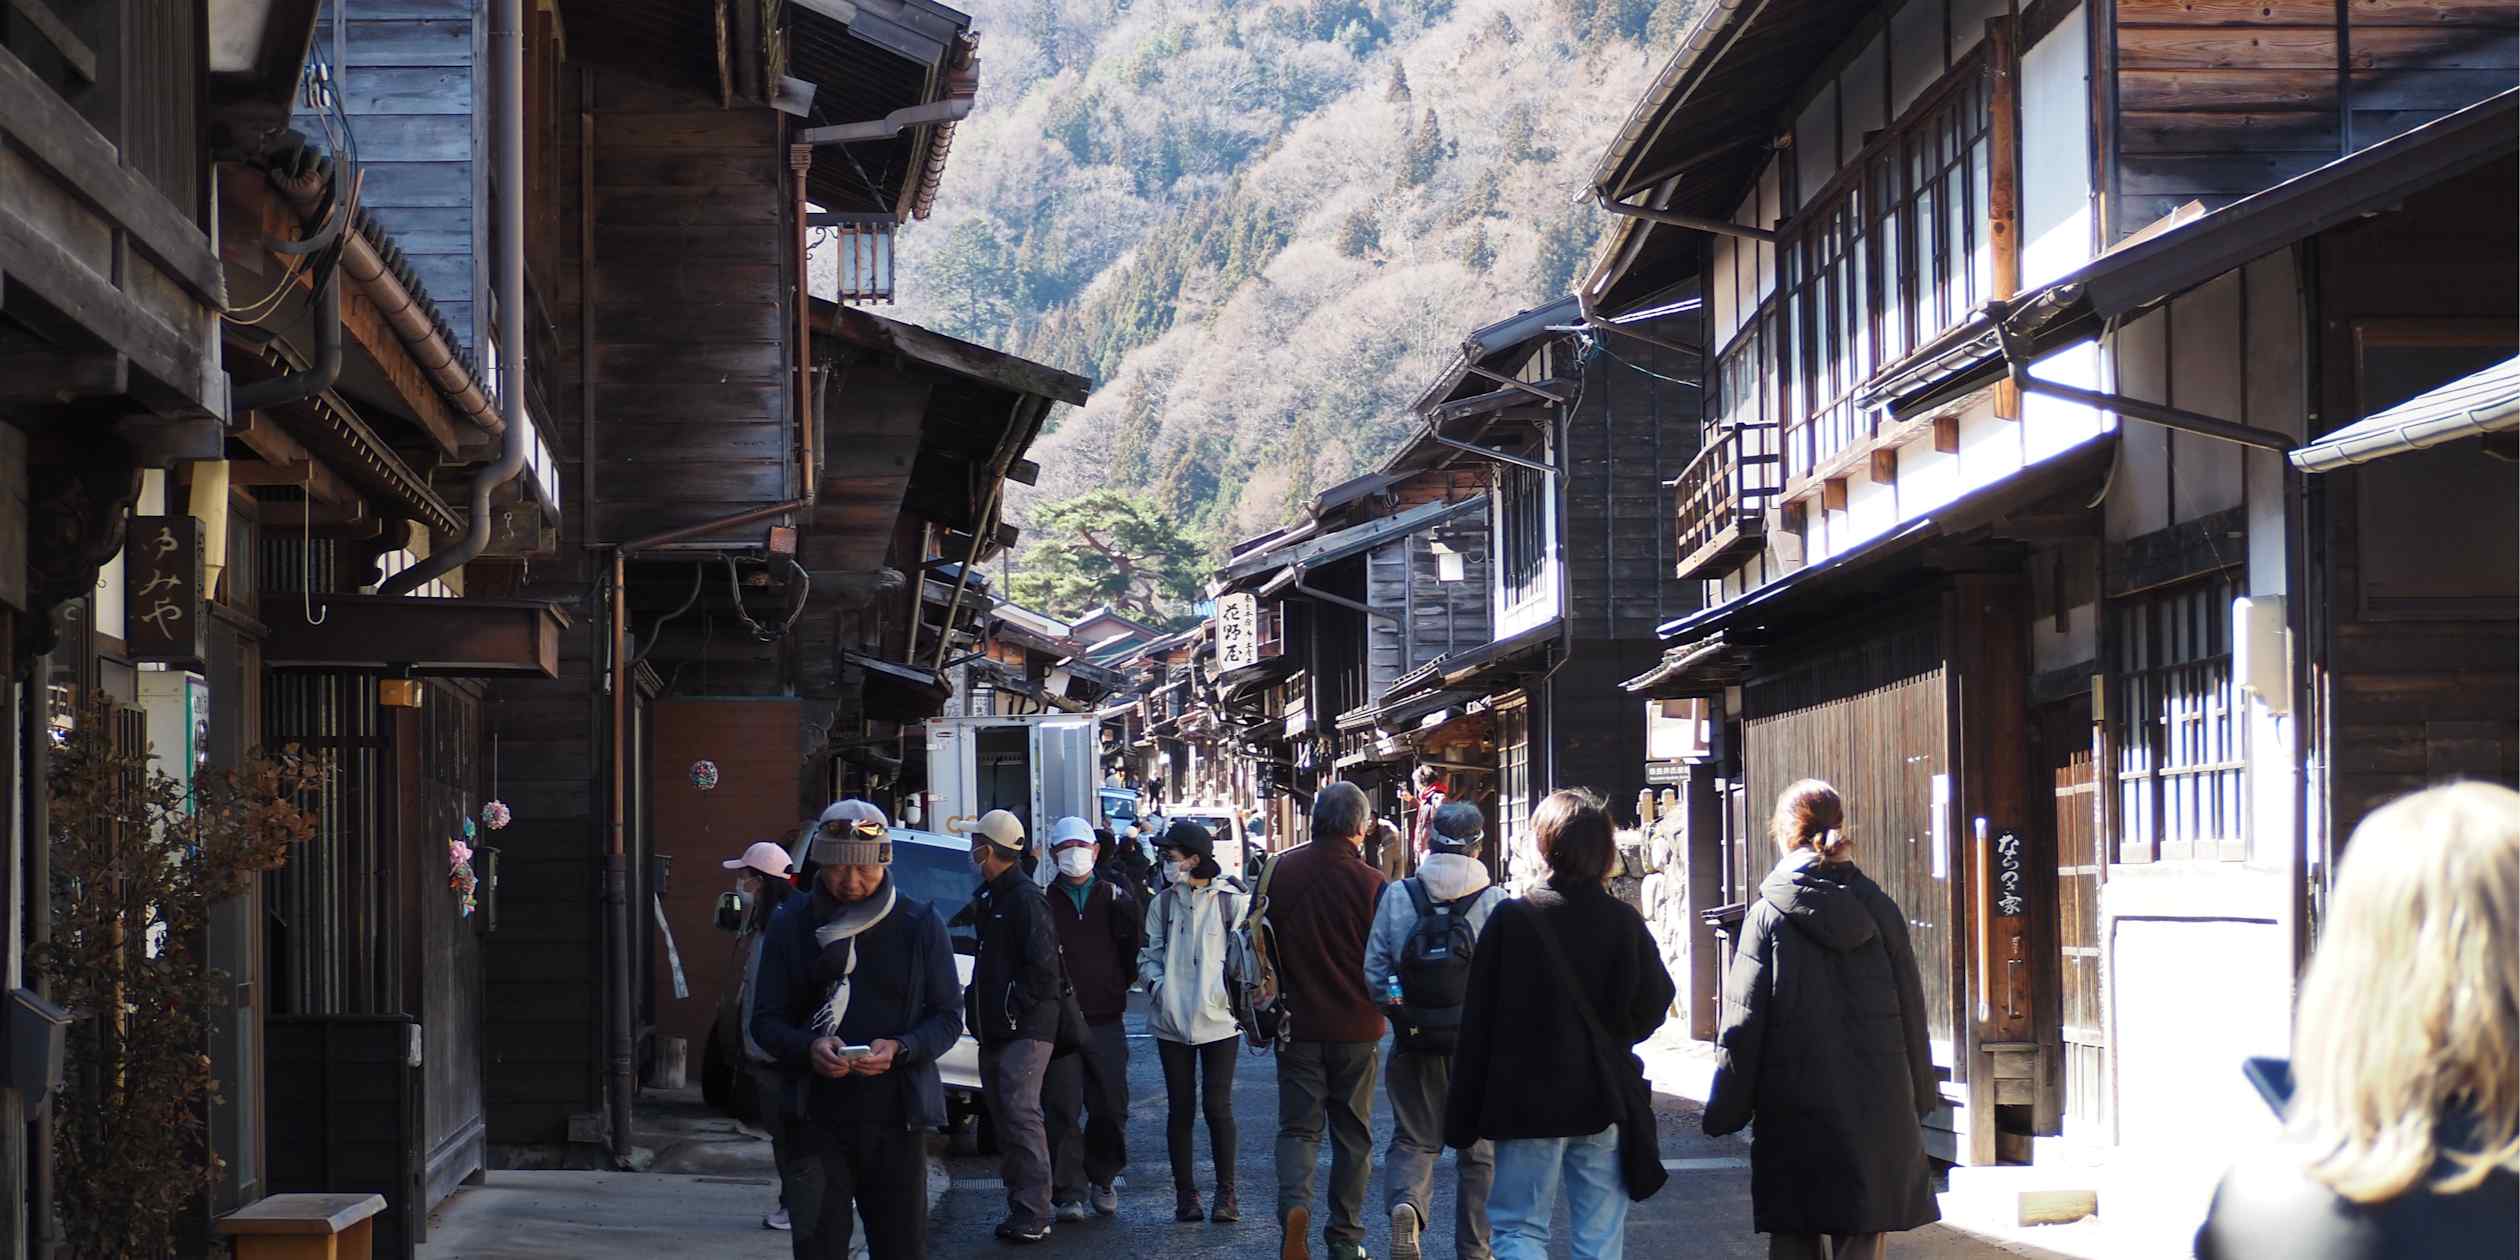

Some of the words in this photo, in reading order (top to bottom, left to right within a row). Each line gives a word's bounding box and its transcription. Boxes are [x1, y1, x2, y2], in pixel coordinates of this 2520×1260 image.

[138, 526, 183, 641] ゆみや
[1222, 603, 1243, 663] 花野屋
